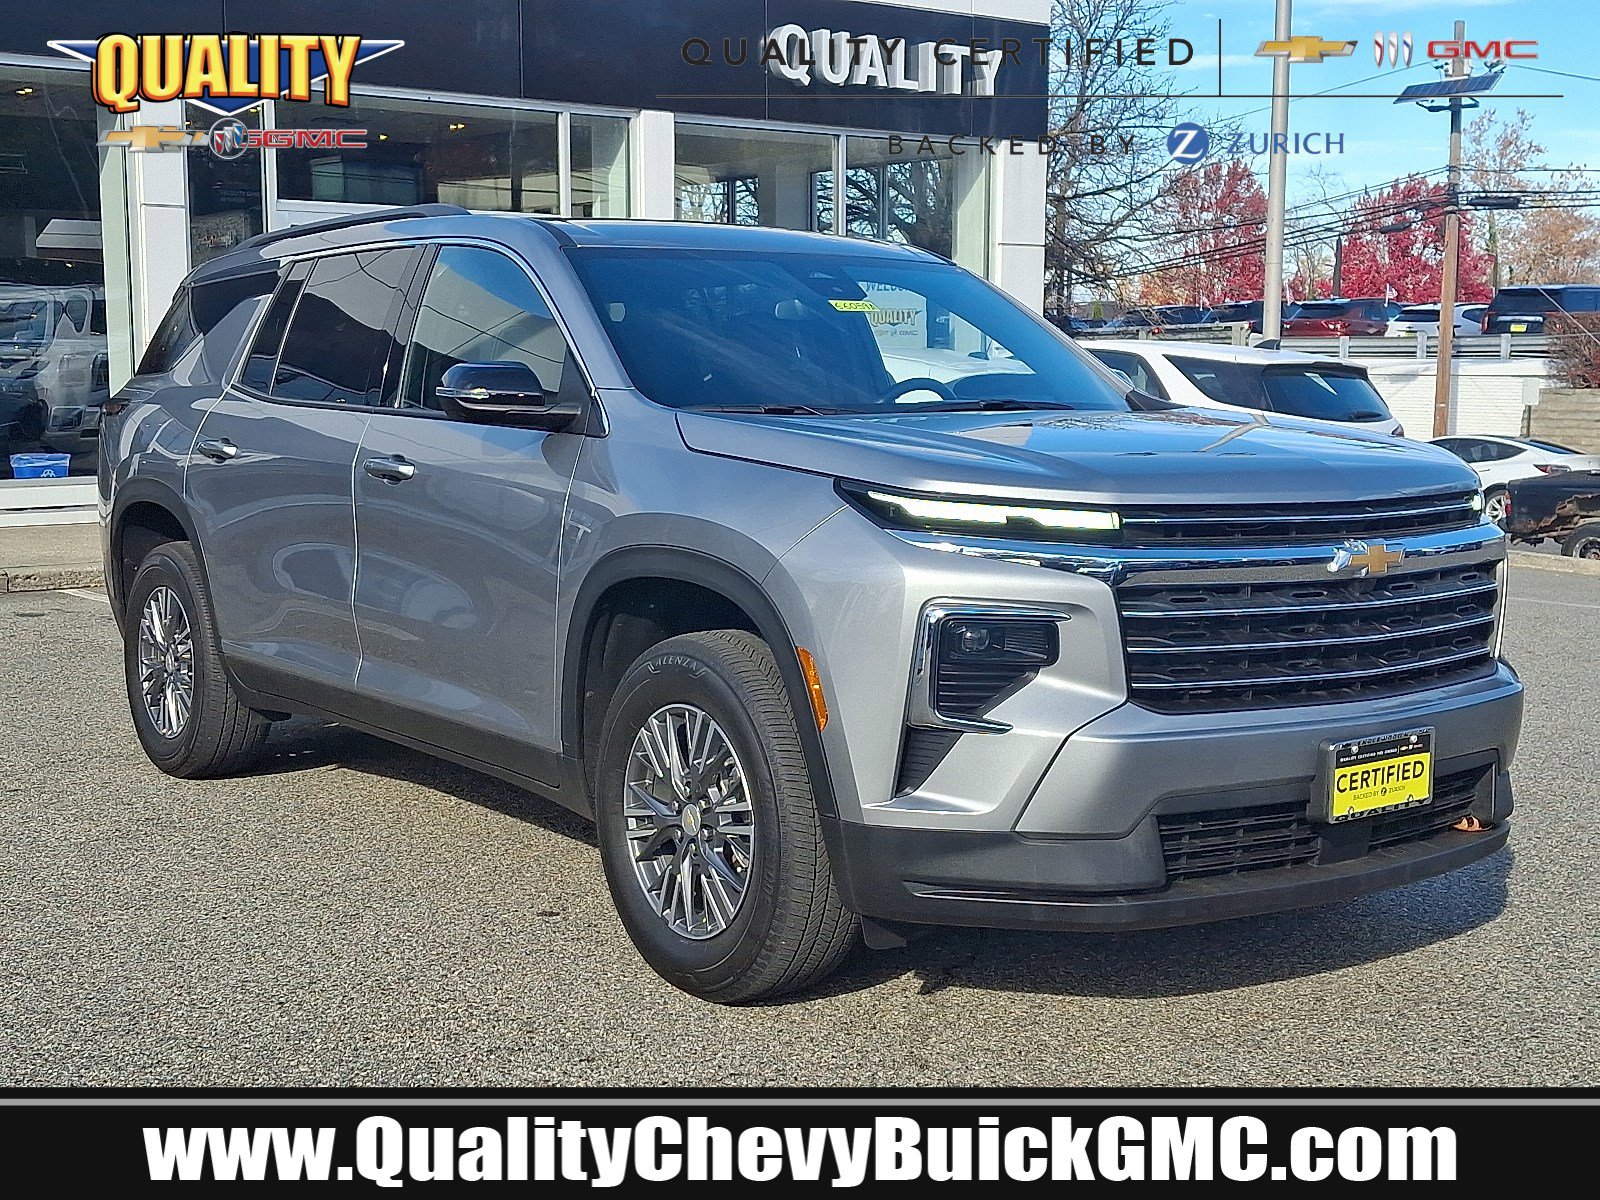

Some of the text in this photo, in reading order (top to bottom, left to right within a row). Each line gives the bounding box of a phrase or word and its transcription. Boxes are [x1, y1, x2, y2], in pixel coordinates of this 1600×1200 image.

[768, 23, 1003, 97] QUALITY
[870, 308, 917, 327] QUALITY
[1336, 760, 1425, 794] CERTIFIED
